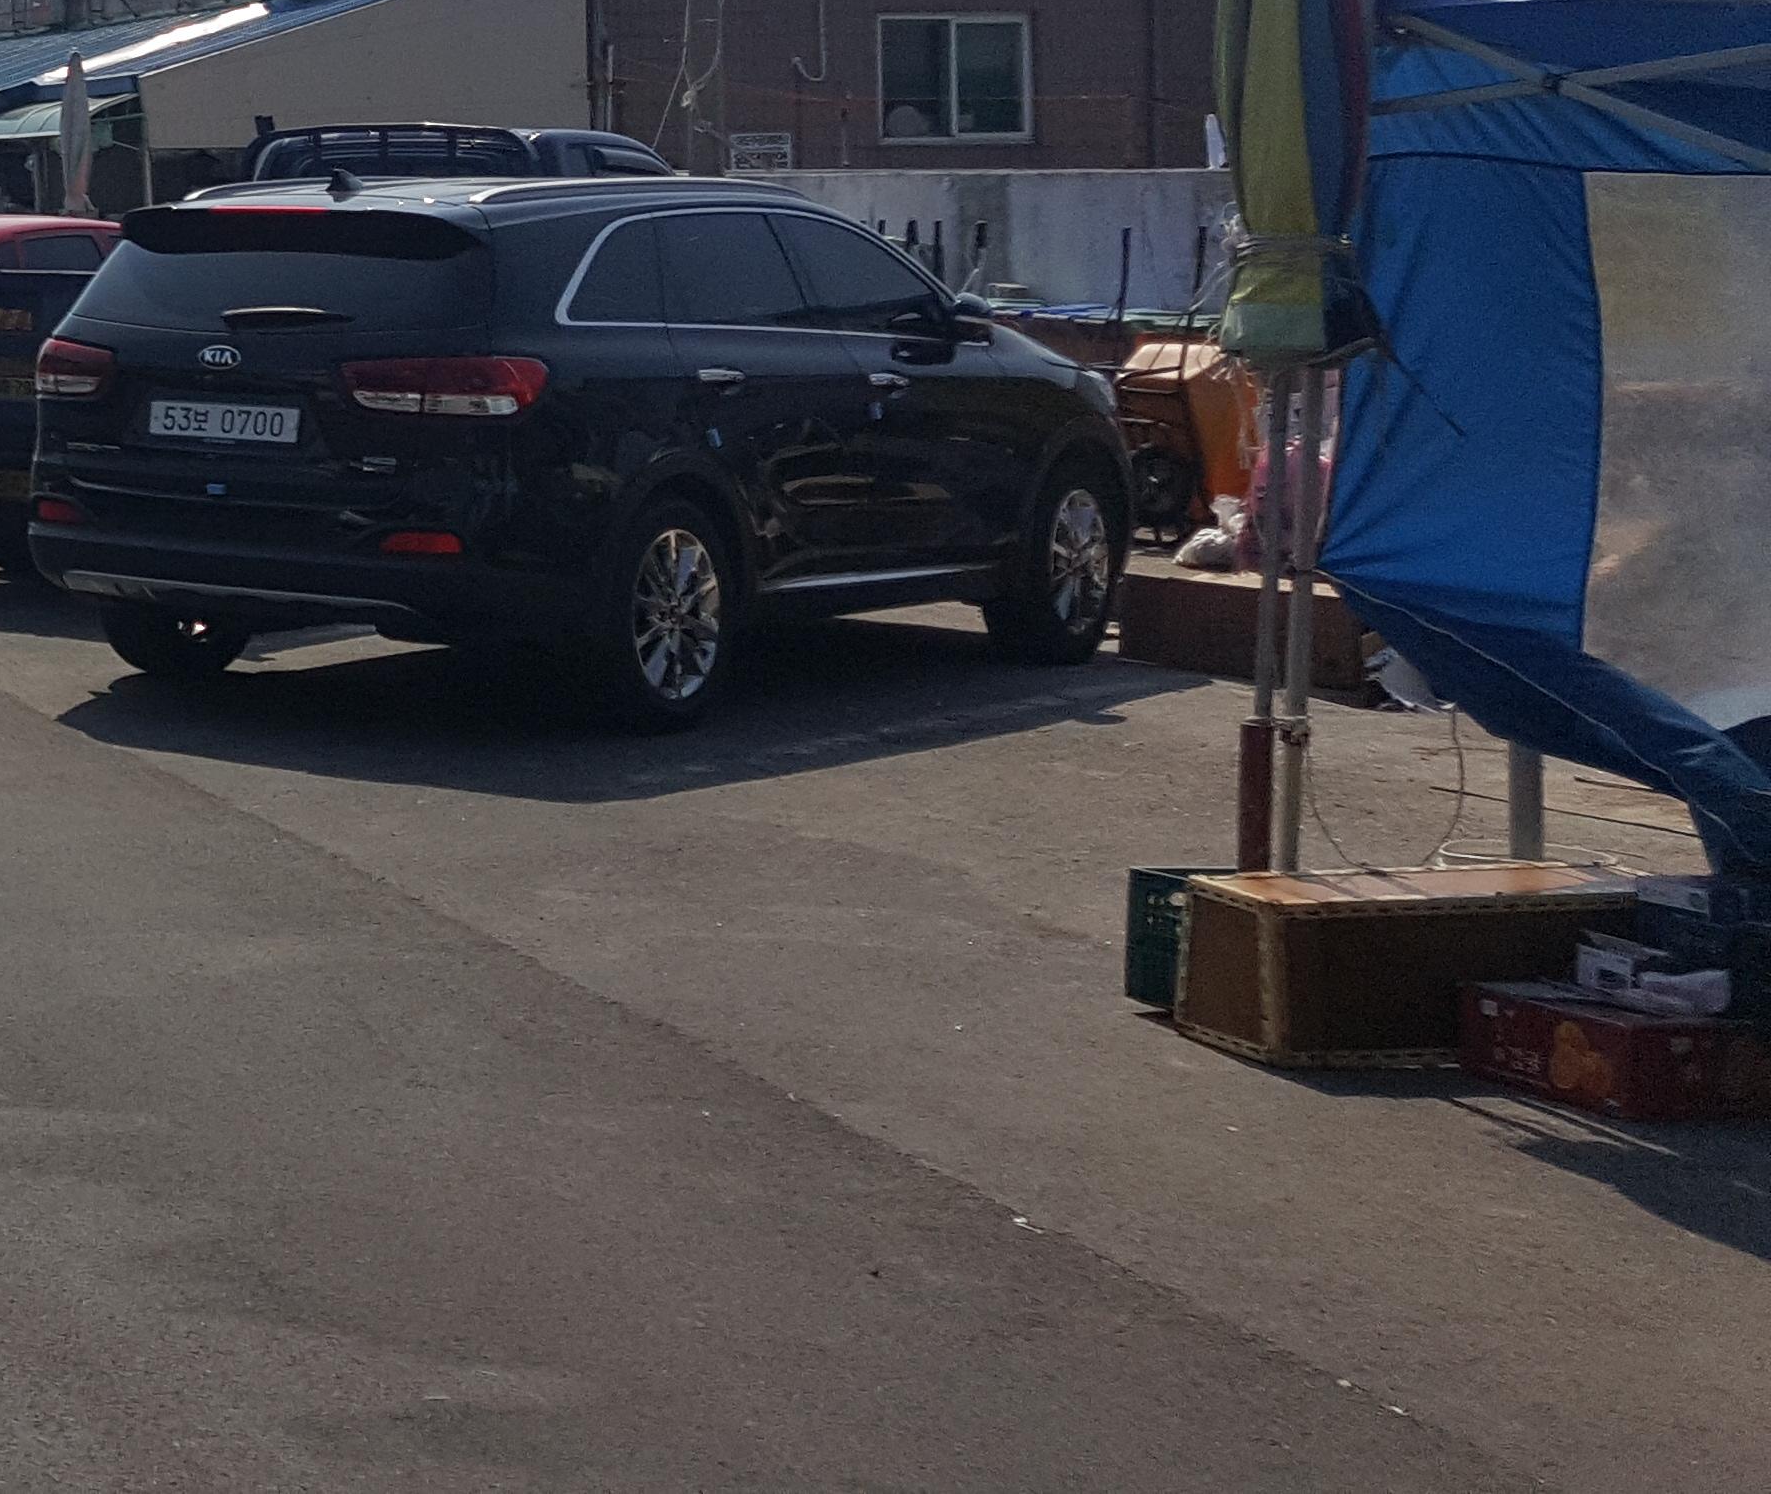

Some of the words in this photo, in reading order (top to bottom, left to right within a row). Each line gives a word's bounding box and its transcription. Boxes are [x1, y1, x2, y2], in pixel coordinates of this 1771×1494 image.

[203, 350, 233, 366] KIA
[162, 405, 209, 432] 53보
[220, 408, 285, 438] 0700
